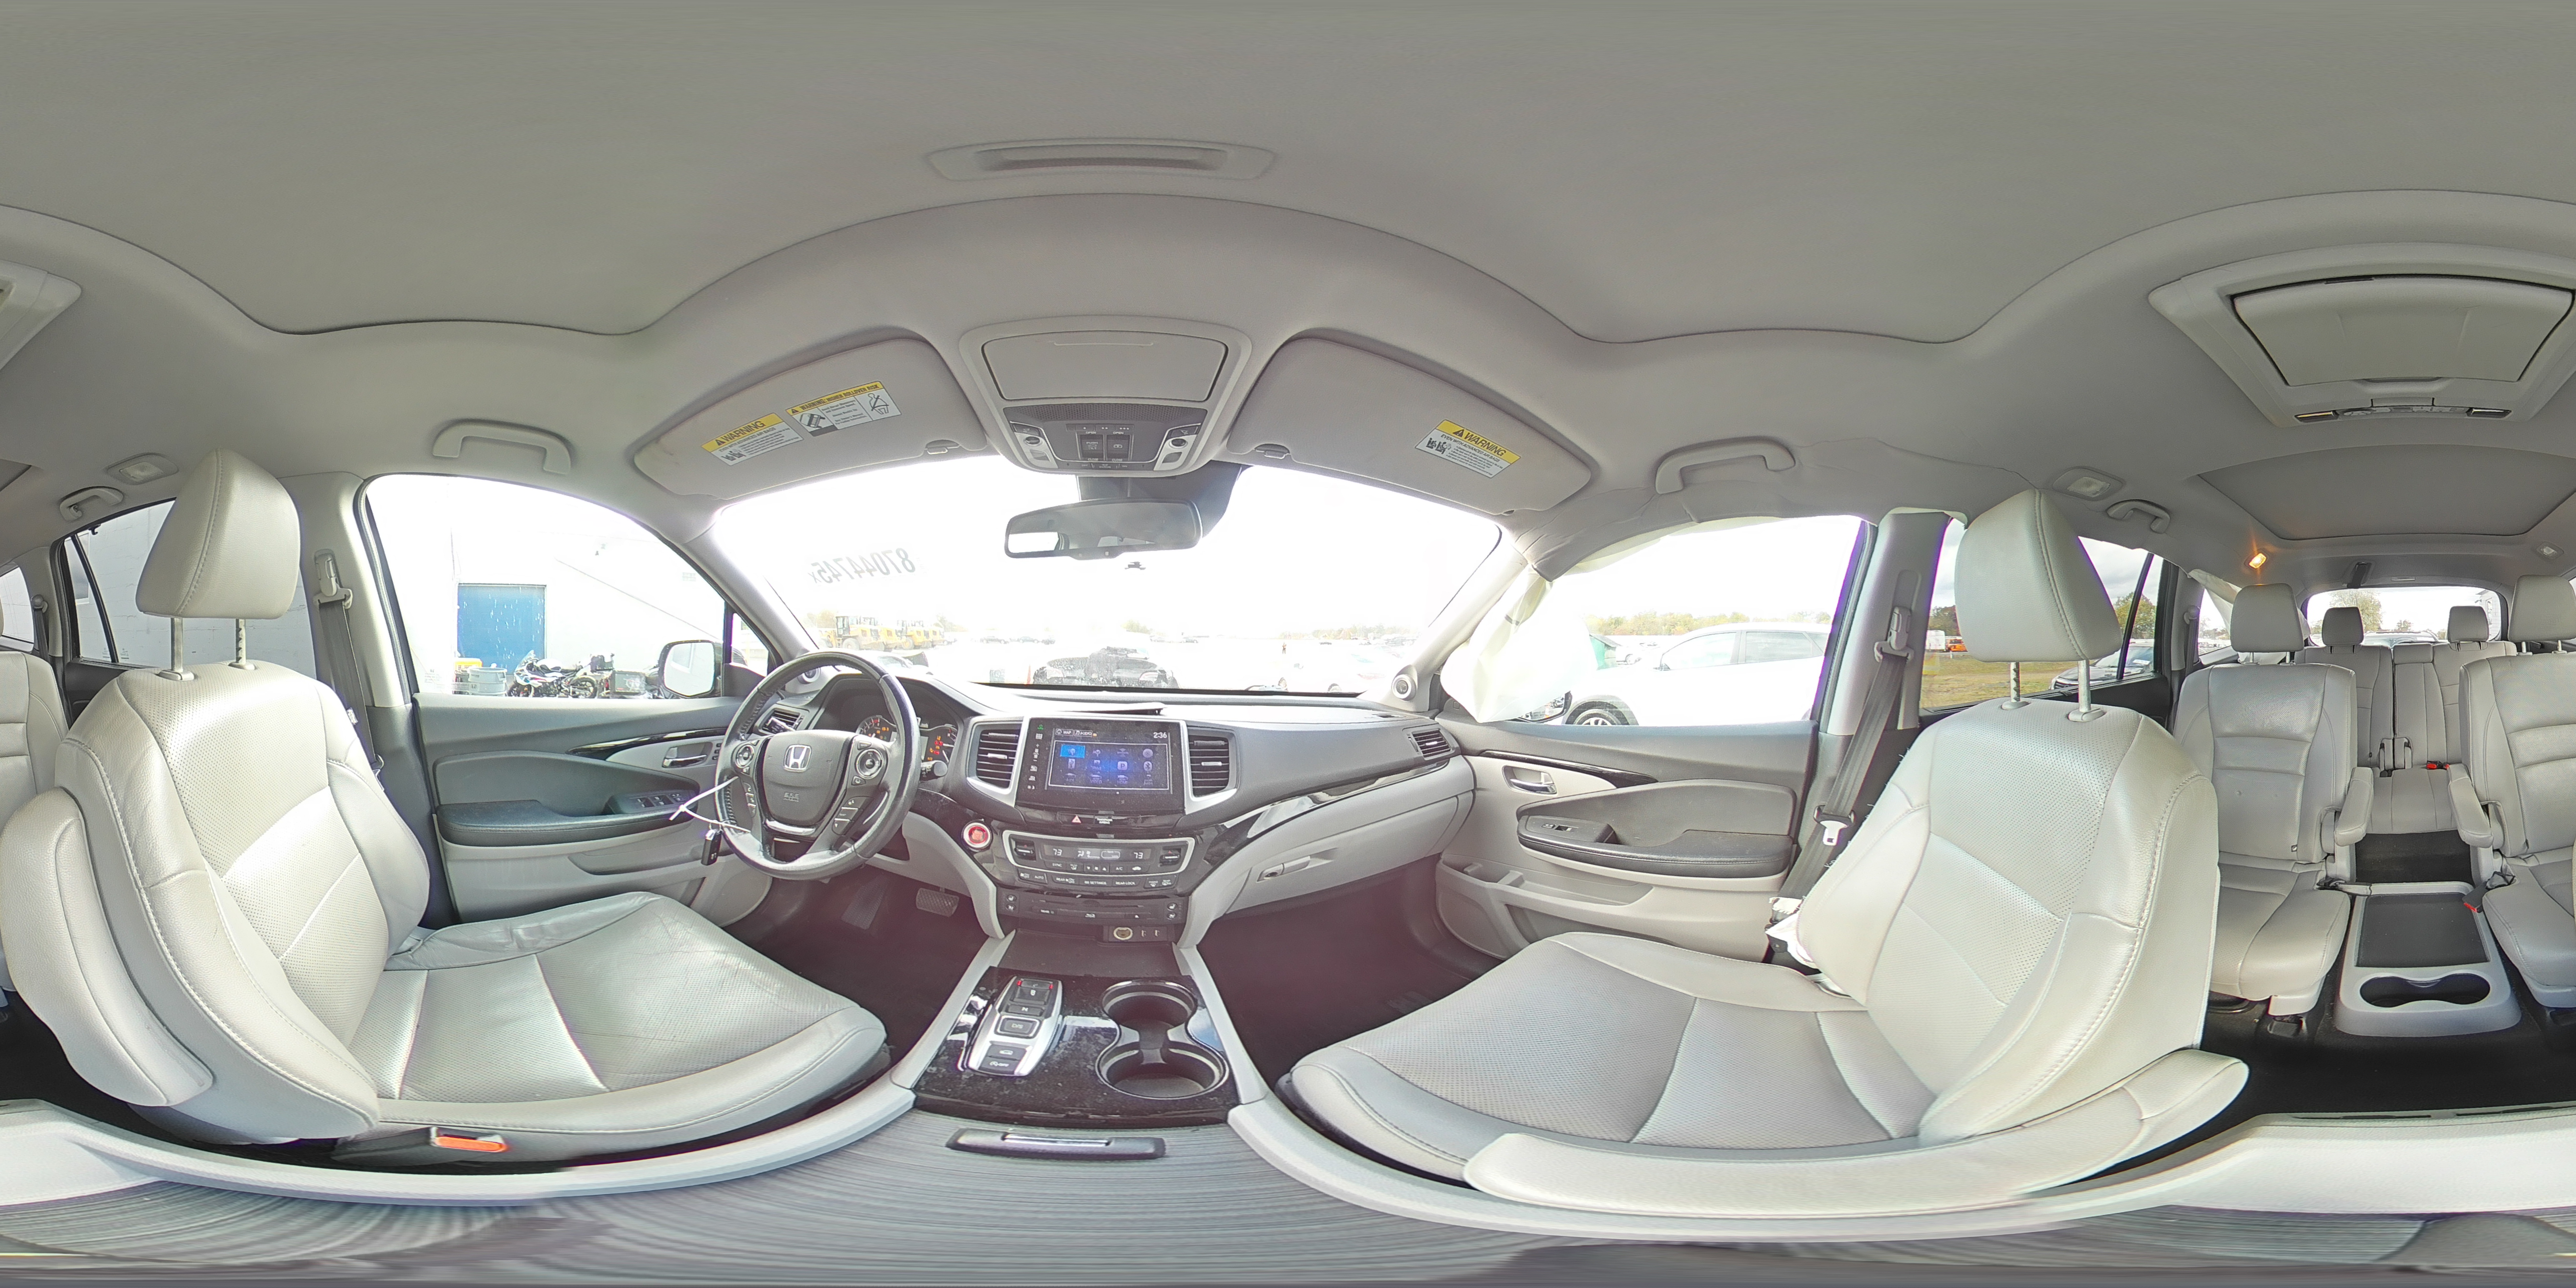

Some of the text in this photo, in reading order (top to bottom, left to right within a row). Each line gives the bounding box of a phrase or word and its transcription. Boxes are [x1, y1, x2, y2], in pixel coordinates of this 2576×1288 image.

[721, 421, 766, 442] WARNING
[1463, 443, 1484, 455] ADVANCED
[1464, 432, 1506, 456] WARNING
